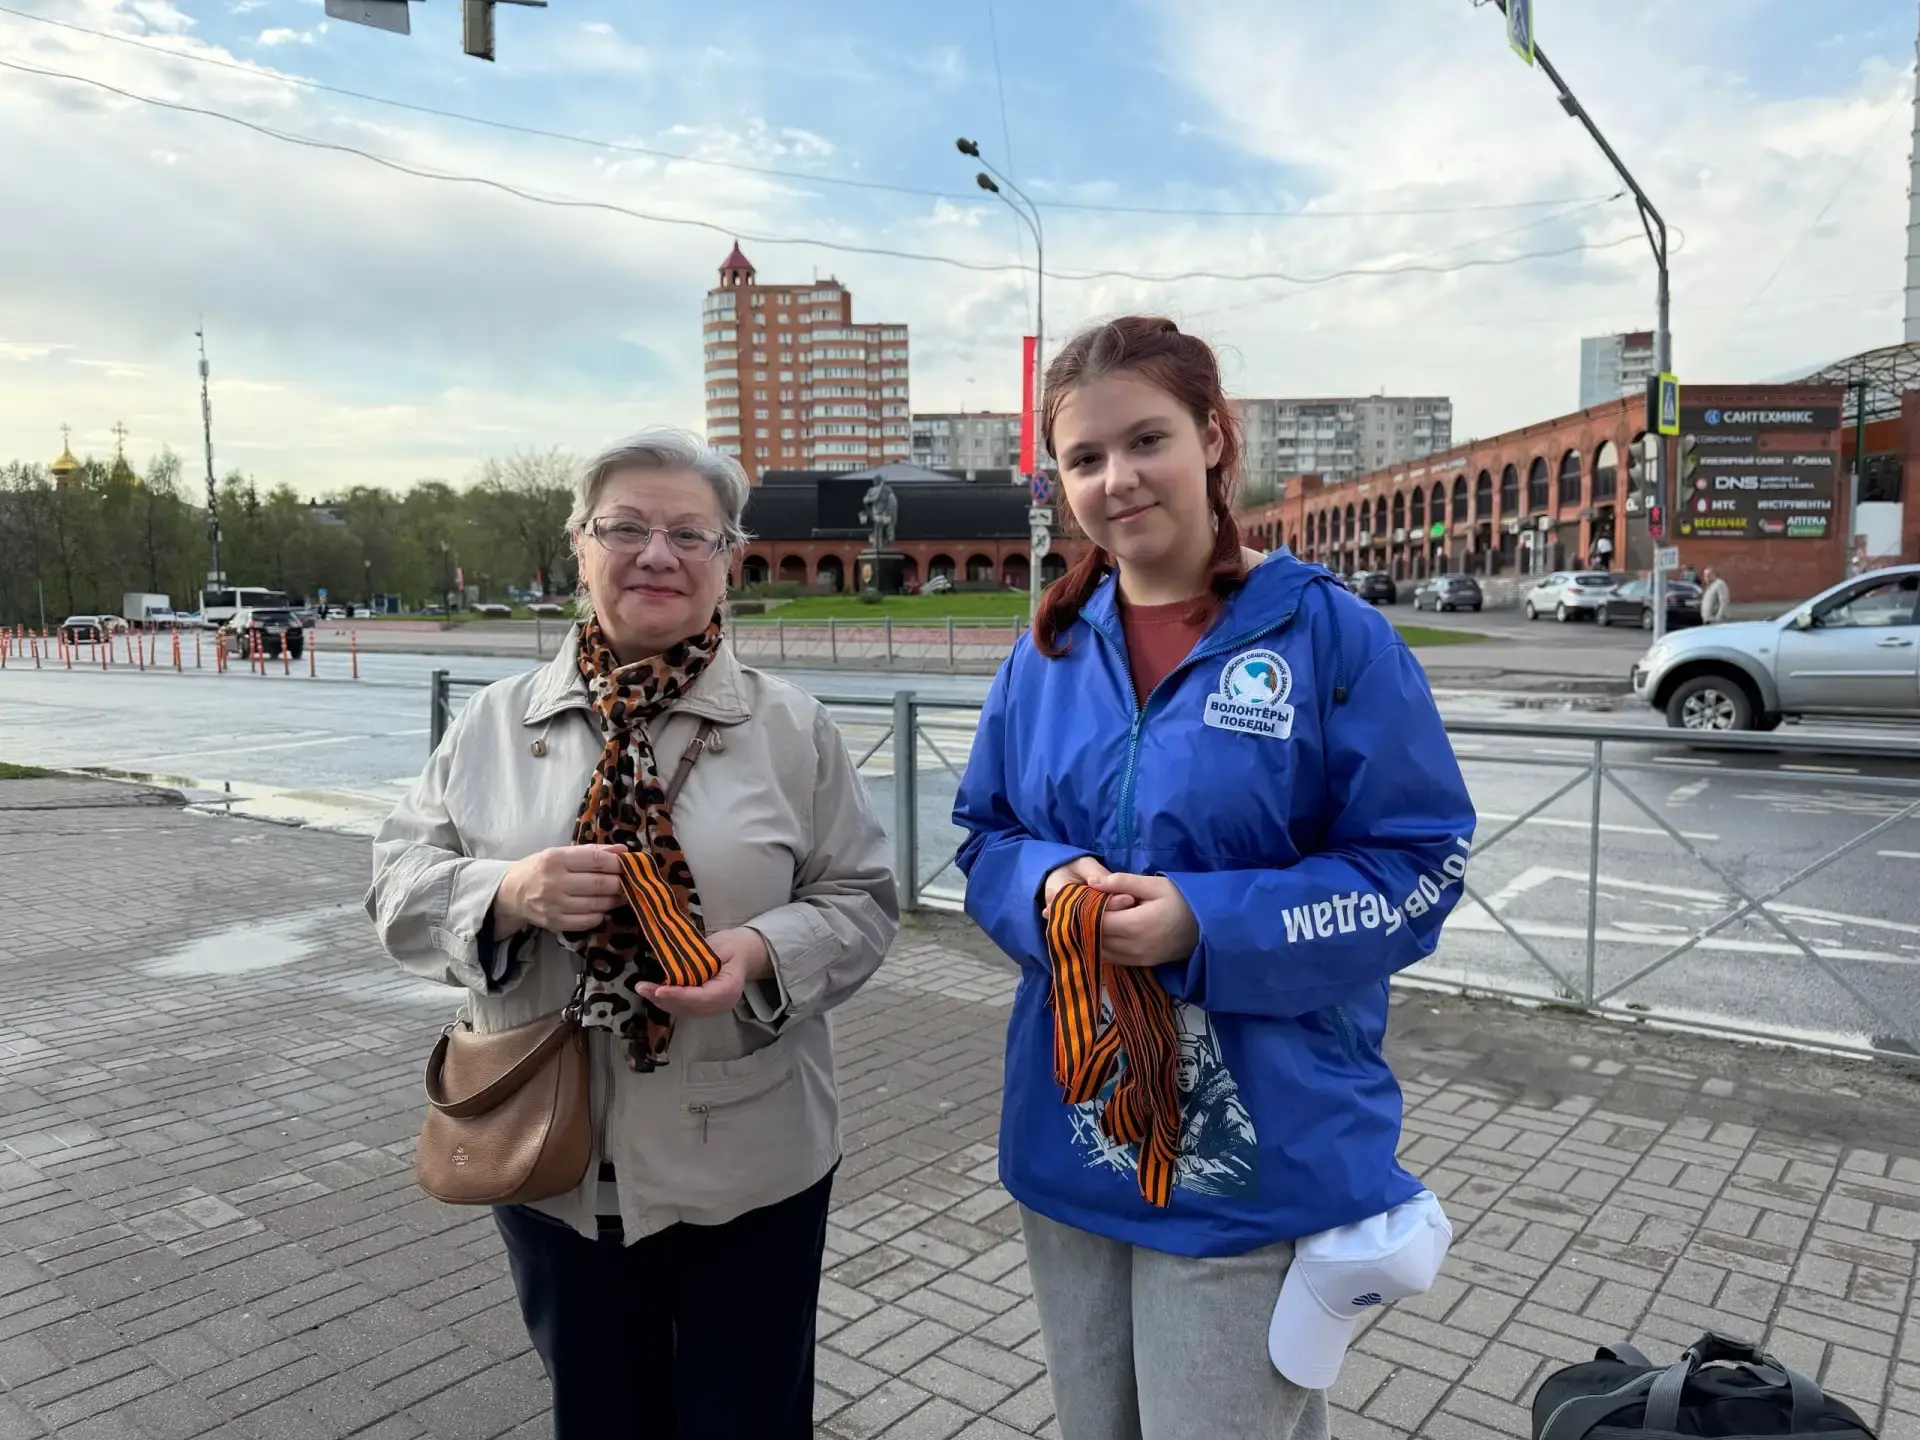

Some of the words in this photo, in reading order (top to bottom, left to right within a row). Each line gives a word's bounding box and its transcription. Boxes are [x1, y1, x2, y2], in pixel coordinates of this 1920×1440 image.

[1723, 411, 1813, 423] САНТЕХМИКС
[1715, 476, 1759, 489] DNS
[1712, 499, 1736, 510] МТС
[1757, 500, 1831, 510] ИНСТРУМЕНТЫ
[1787, 516, 1827, 525] АПТЕКА
[1210, 701, 1289, 722] ВОЛОНТЁРЫ
[1220, 715, 1276, 733] ПОБЕДЫ
